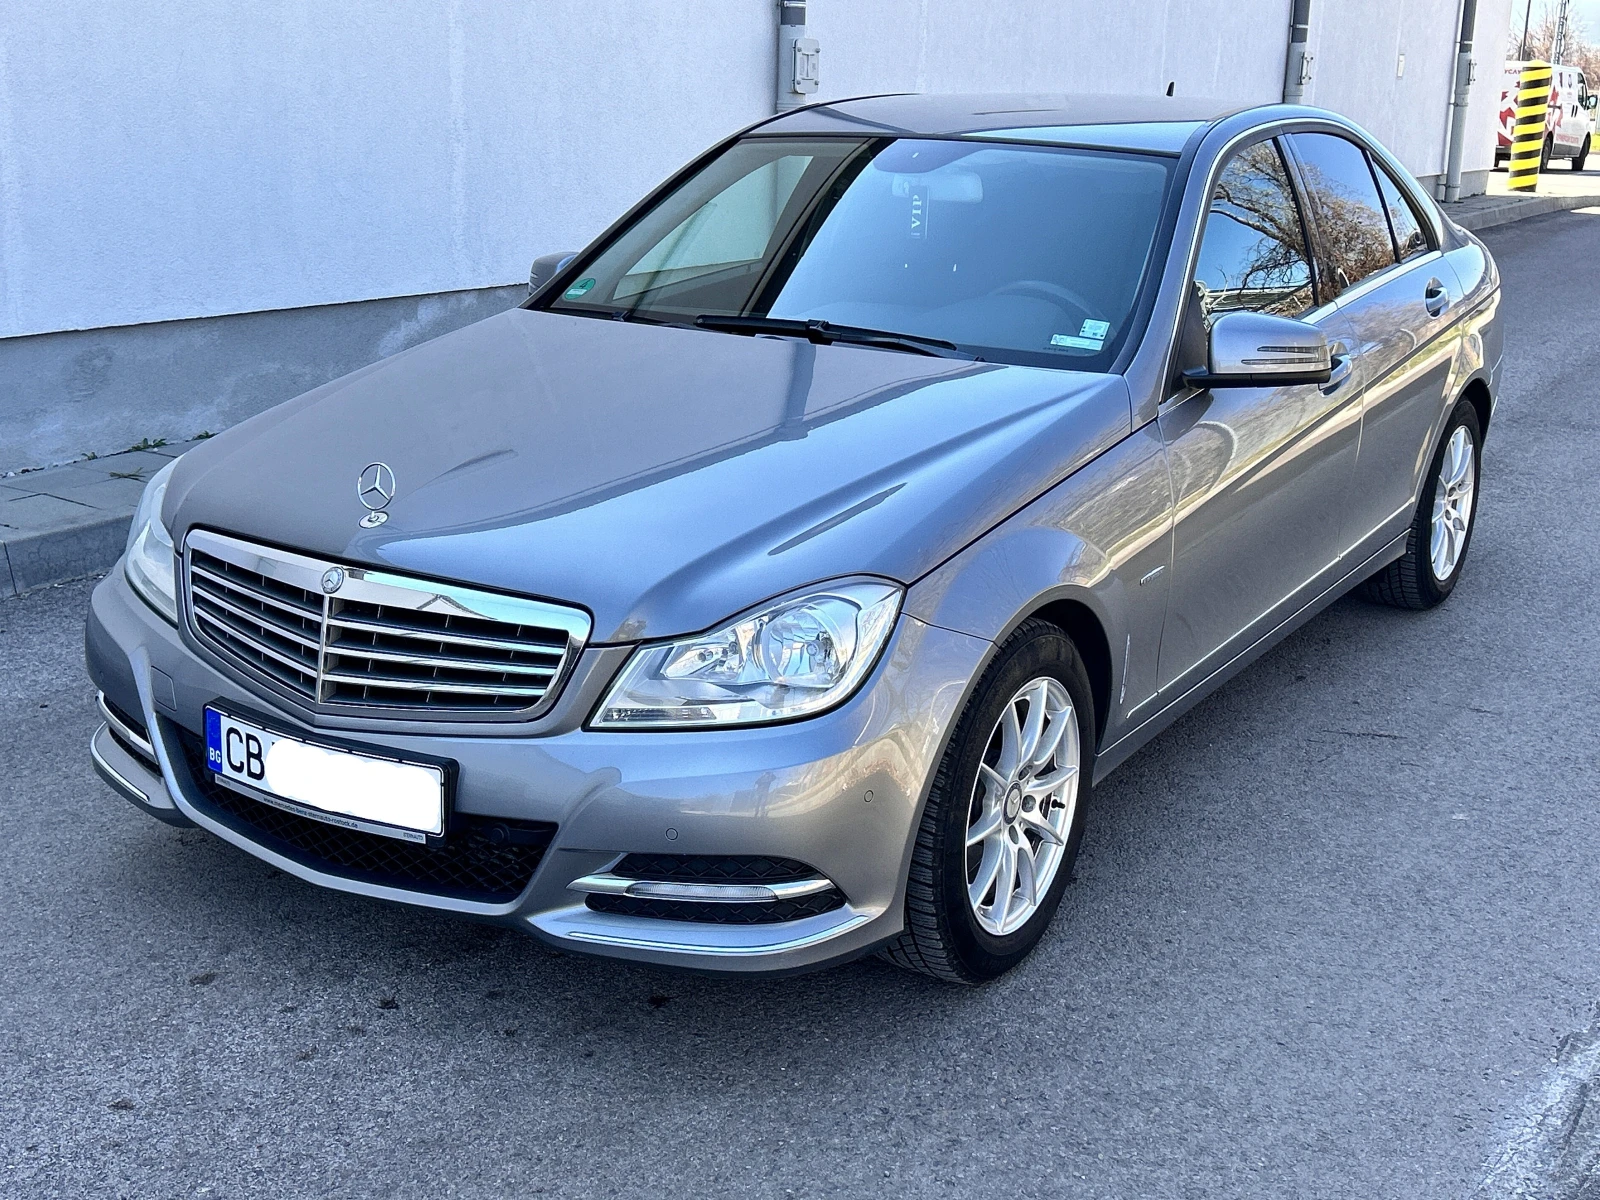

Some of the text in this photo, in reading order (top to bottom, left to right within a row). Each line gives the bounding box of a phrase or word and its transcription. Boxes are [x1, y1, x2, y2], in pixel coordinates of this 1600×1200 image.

[911, 194, 922, 229] VIP
[579, 279, 590, 289] 4
[209, 746, 221, 764] BG
[226, 726, 265, 780] CB
